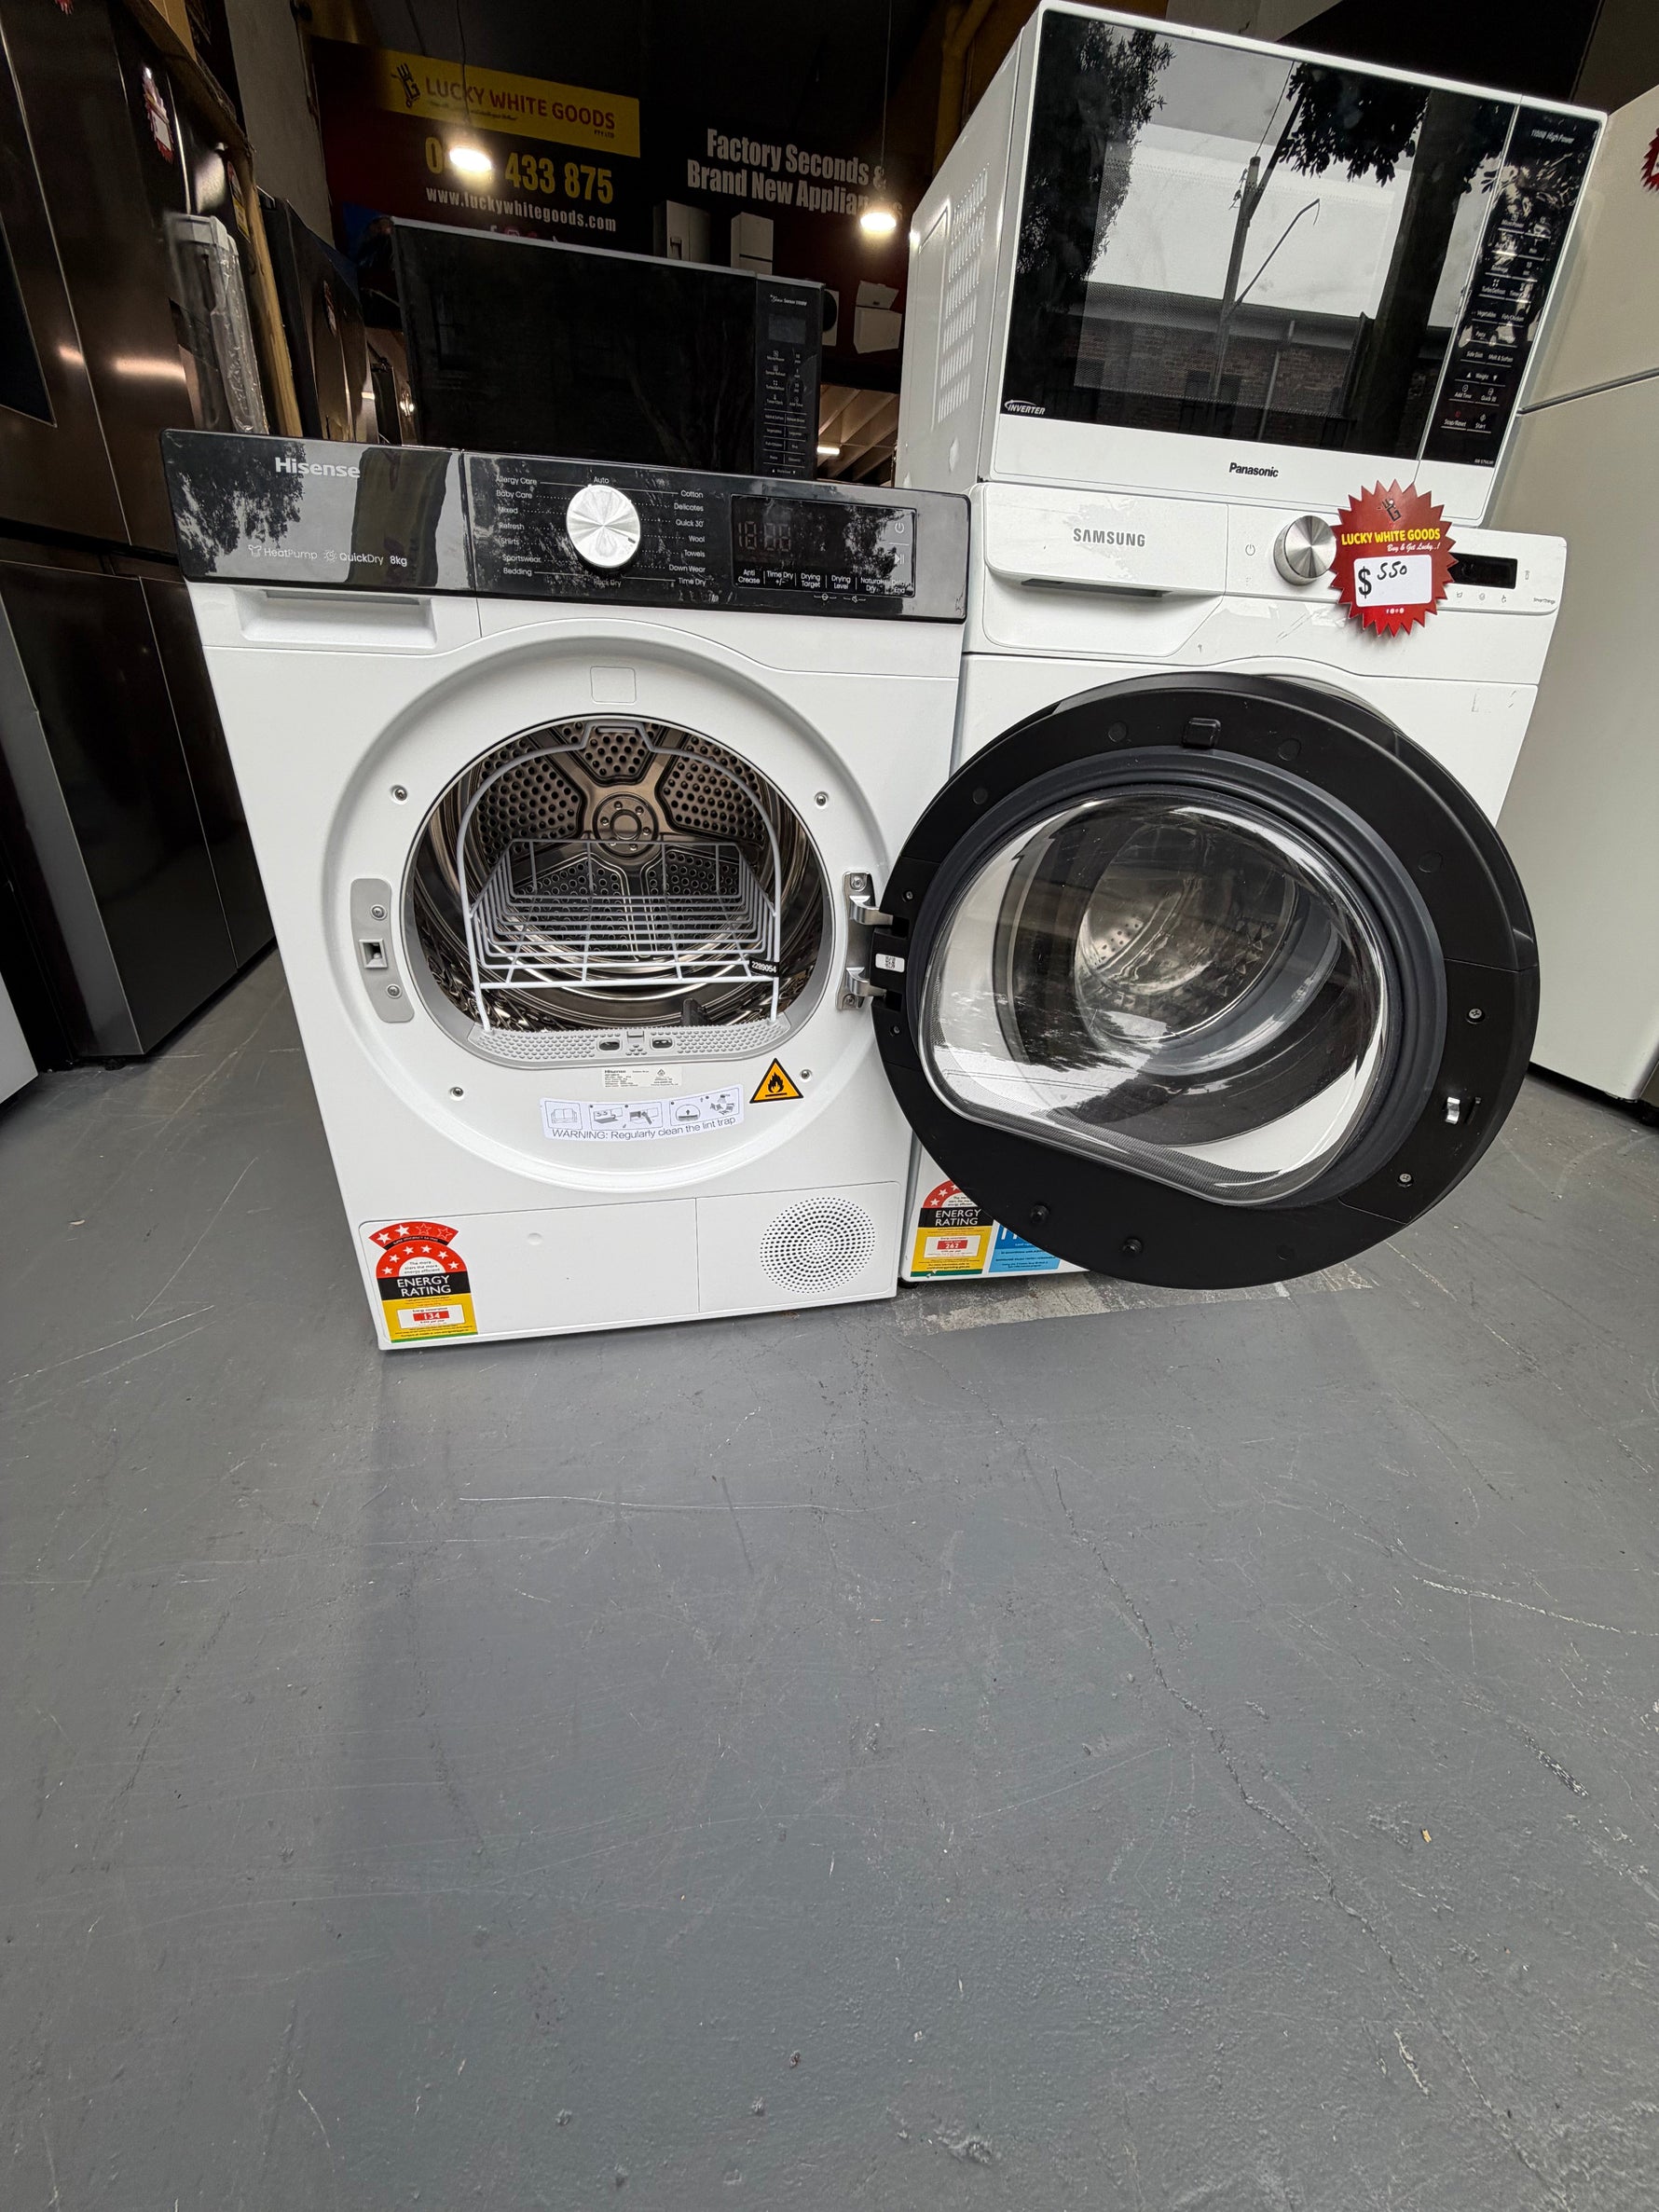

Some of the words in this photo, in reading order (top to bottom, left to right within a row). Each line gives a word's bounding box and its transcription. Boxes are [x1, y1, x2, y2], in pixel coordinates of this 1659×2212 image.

[426, 76, 485, 104] LUCKY
[489, 89, 548, 117] WHITE
[552, 102, 615, 130] GOODS
[706, 128, 782, 172] Factory
[785, 144, 870, 186] Seconds
[505, 152, 555, 195] 433
[565, 162, 613, 204] 875
[687, 158, 747, 197] Brand
[751, 172, 793, 206] New
[426, 186, 616, 232] www.luckywhitegoods.com
[1007, 403, 1046, 416] INVERTER
[1444, 419, 1466, 427] Stop/Reset
[275, 457, 361, 478] Hisense
[1228, 462, 1279, 478] Panasonic
[496, 474, 519, 485] Allergy
[496, 489, 514, 499] Baby
[680, 489, 704, 499] Cotton
[498, 506, 518, 515] Mixed
[674, 502, 705, 512] Delicates
[499, 522, 525, 530] Refresh
[675, 518, 694, 527] Quick
[500, 537, 520, 545] Shirts
[1073, 528, 1146, 547] SAMSUNG
[1341, 532, 1373, 545] LUCKY
[1374, 529, 1405, 543] WHITE
[1407, 528, 1441, 542] GOODS
[684, 549, 706, 557] Towels
[1387, 543, 1399, 553] Buy
[1405, 543, 1416, 553] Get
[264, 547, 318, 560] HeatPump
[339, 552, 384, 566] QuickDry
[390, 555, 408, 568] 8kg
[502, 554, 542, 563] Sportswear
[503, 567, 532, 577] Bedding
[668, 564, 688, 572] Down
[689, 565, 706, 573] Wear
[737, 576, 761, 584] Crease
[783, 571, 794, 581] Dry
[801, 574, 821, 583] Drying
[831, 575, 851, 584] Drying
[1358, 565, 1372, 599] $
[1377, 560, 1407, 581] 550
[610, 579, 622, 588] Dry
[694, 578, 706, 586] Dry
[802, 581, 820, 589] Target
[866, 584, 876, 594] Dry
[552, 1129, 609, 1139] WARNING:
[610, 1129, 656, 1140] Regularly
[658, 1126, 683, 1136] clean
[685, 1122, 700, 1133] the
[702, 1120, 716, 1131] lint
[717, 1116, 736, 1129] trap
[935, 1209, 981, 1218] ENERGY
[935, 1217, 979, 1226] RATING
[396, 1275, 450, 1287] ENERGY
[401, 1285, 452, 1297] RATING
